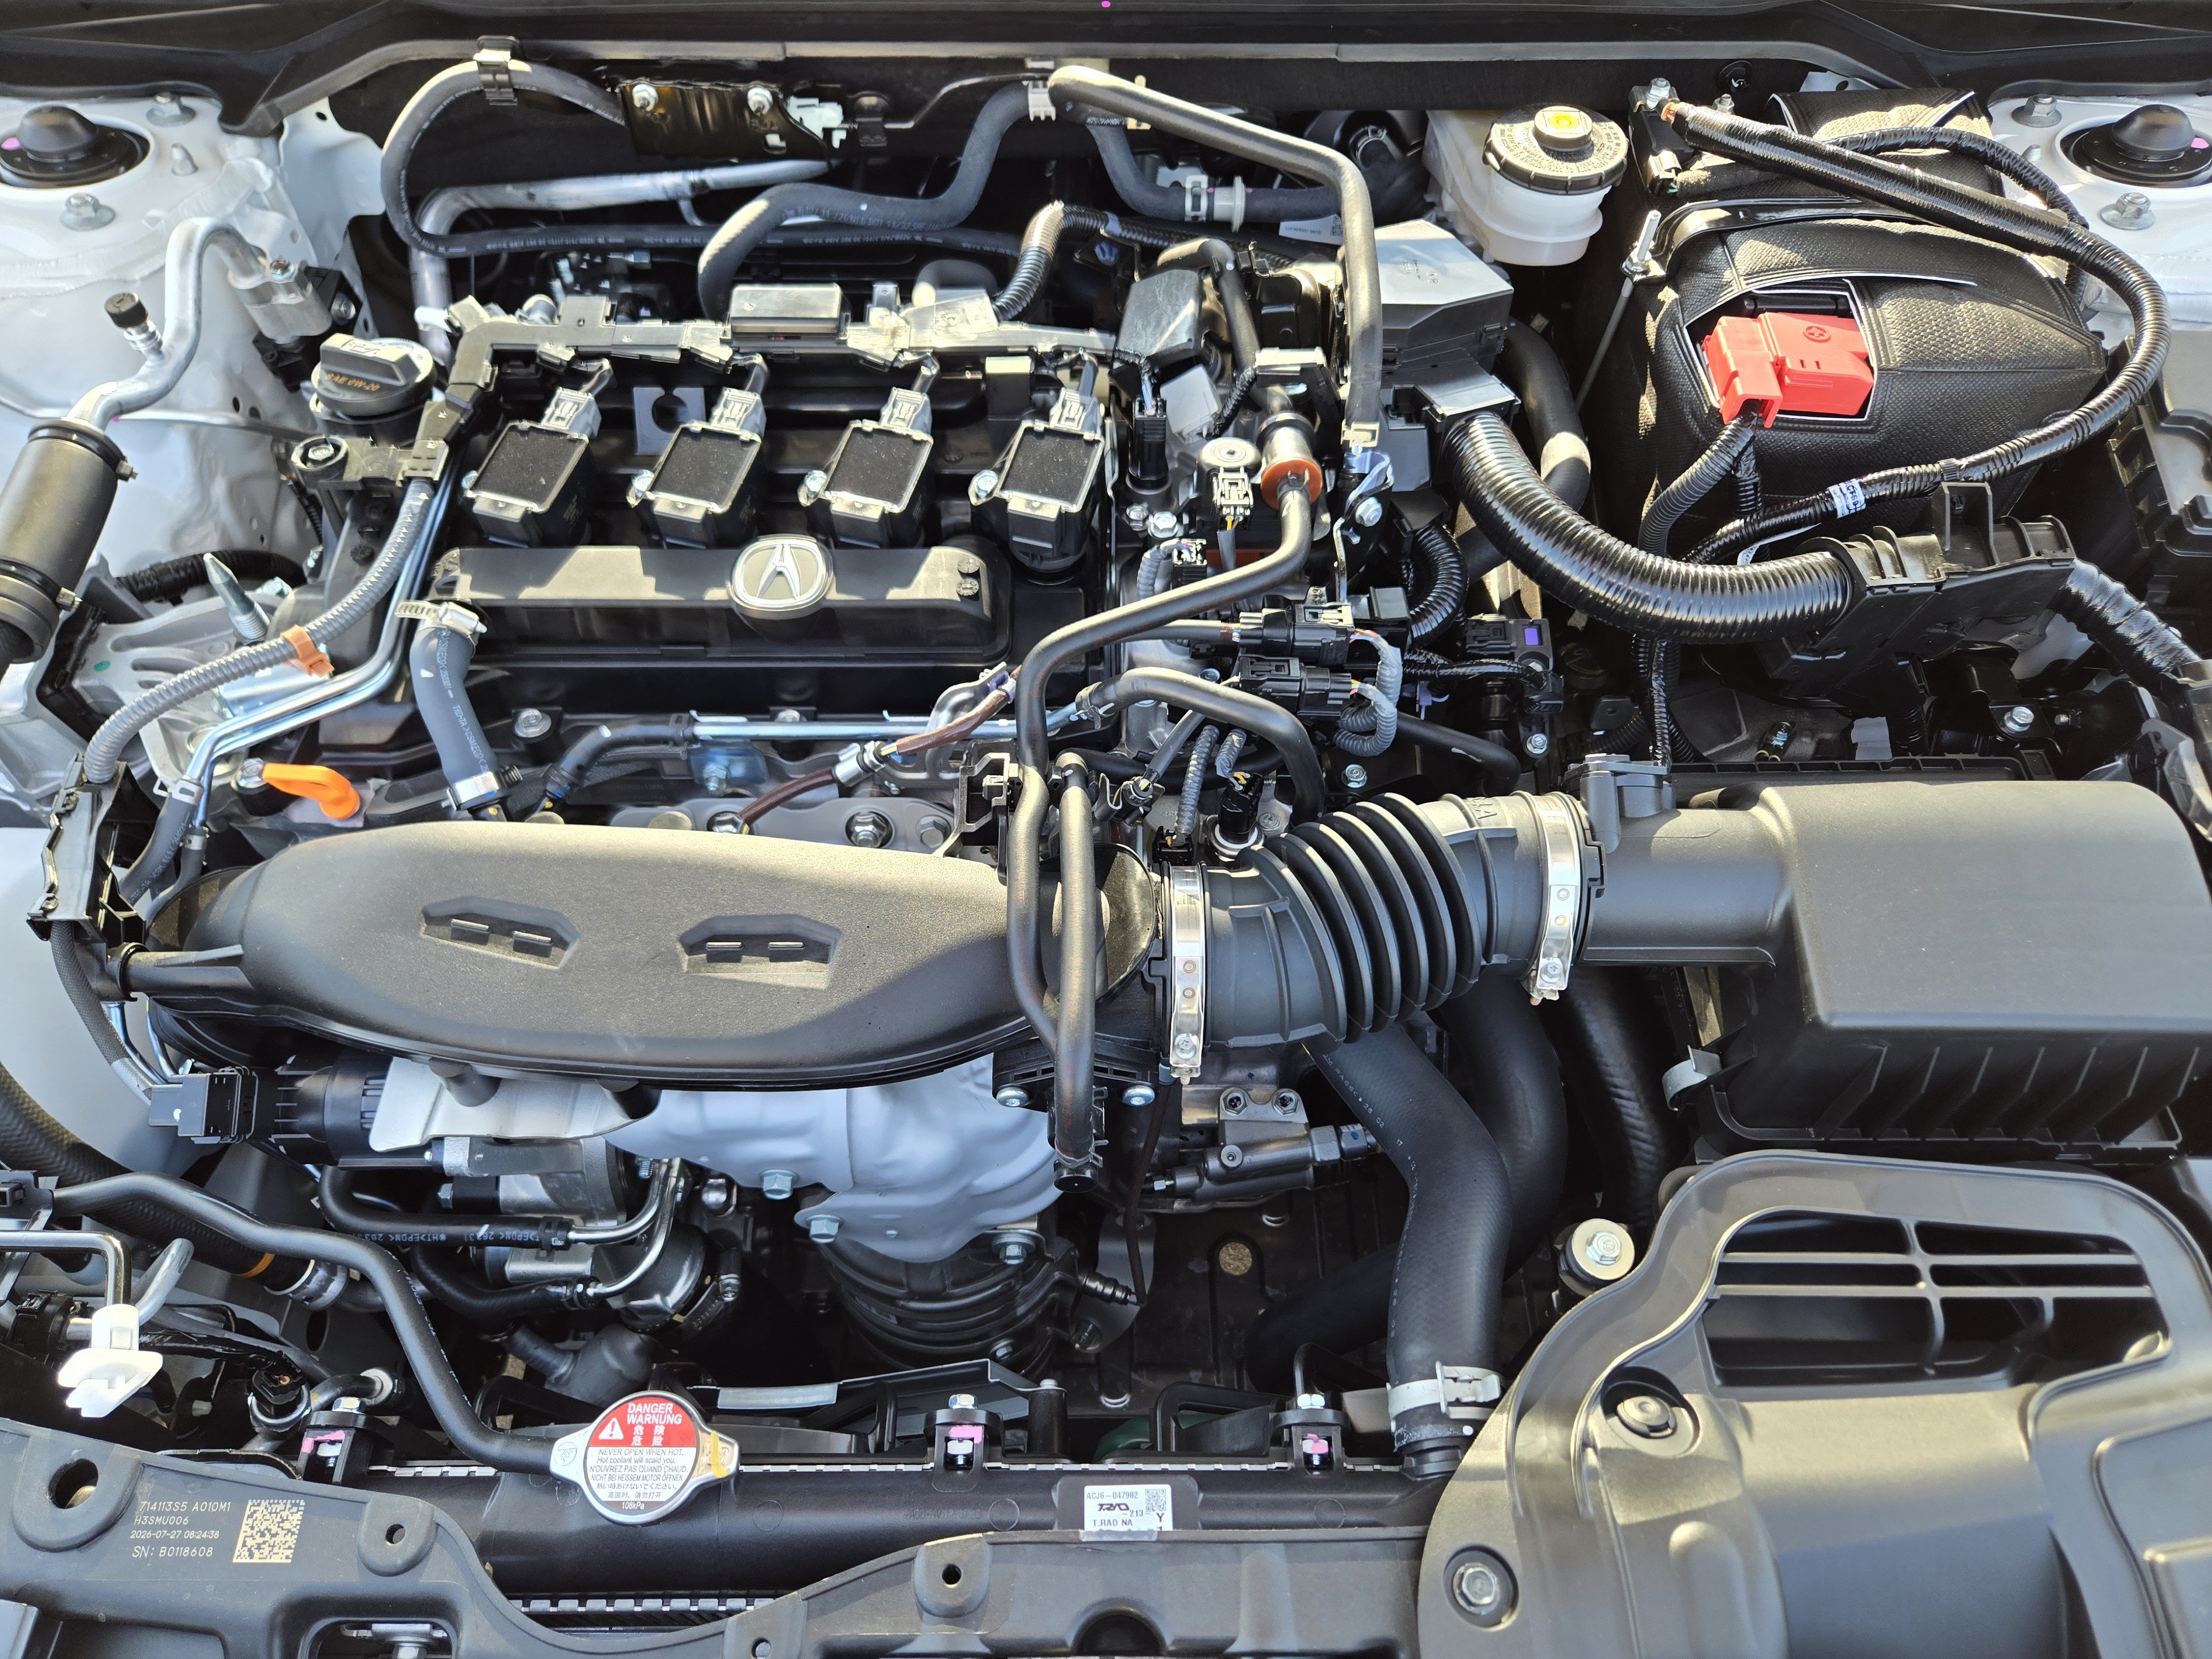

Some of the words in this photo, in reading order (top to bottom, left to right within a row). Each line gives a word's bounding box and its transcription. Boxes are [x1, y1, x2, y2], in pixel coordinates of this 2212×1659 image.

[627, 1403, 674, 1414] DANGER
[626, 1413, 682, 1425] WARNUNG
[139, 1501, 188, 1512] 714113S5
[622, 1501, 645, 1510] 108kPa
[134, 1516, 189, 1525] H3SMU006
[1156, 1512, 1165, 1523] Y
[129, 1530, 182, 1539] 2026-07-27
[184, 1530, 220, 1539] 08:24:38
[132, 1546, 155, 1558] SN:
[158, 1546, 213, 1557] B0118608
